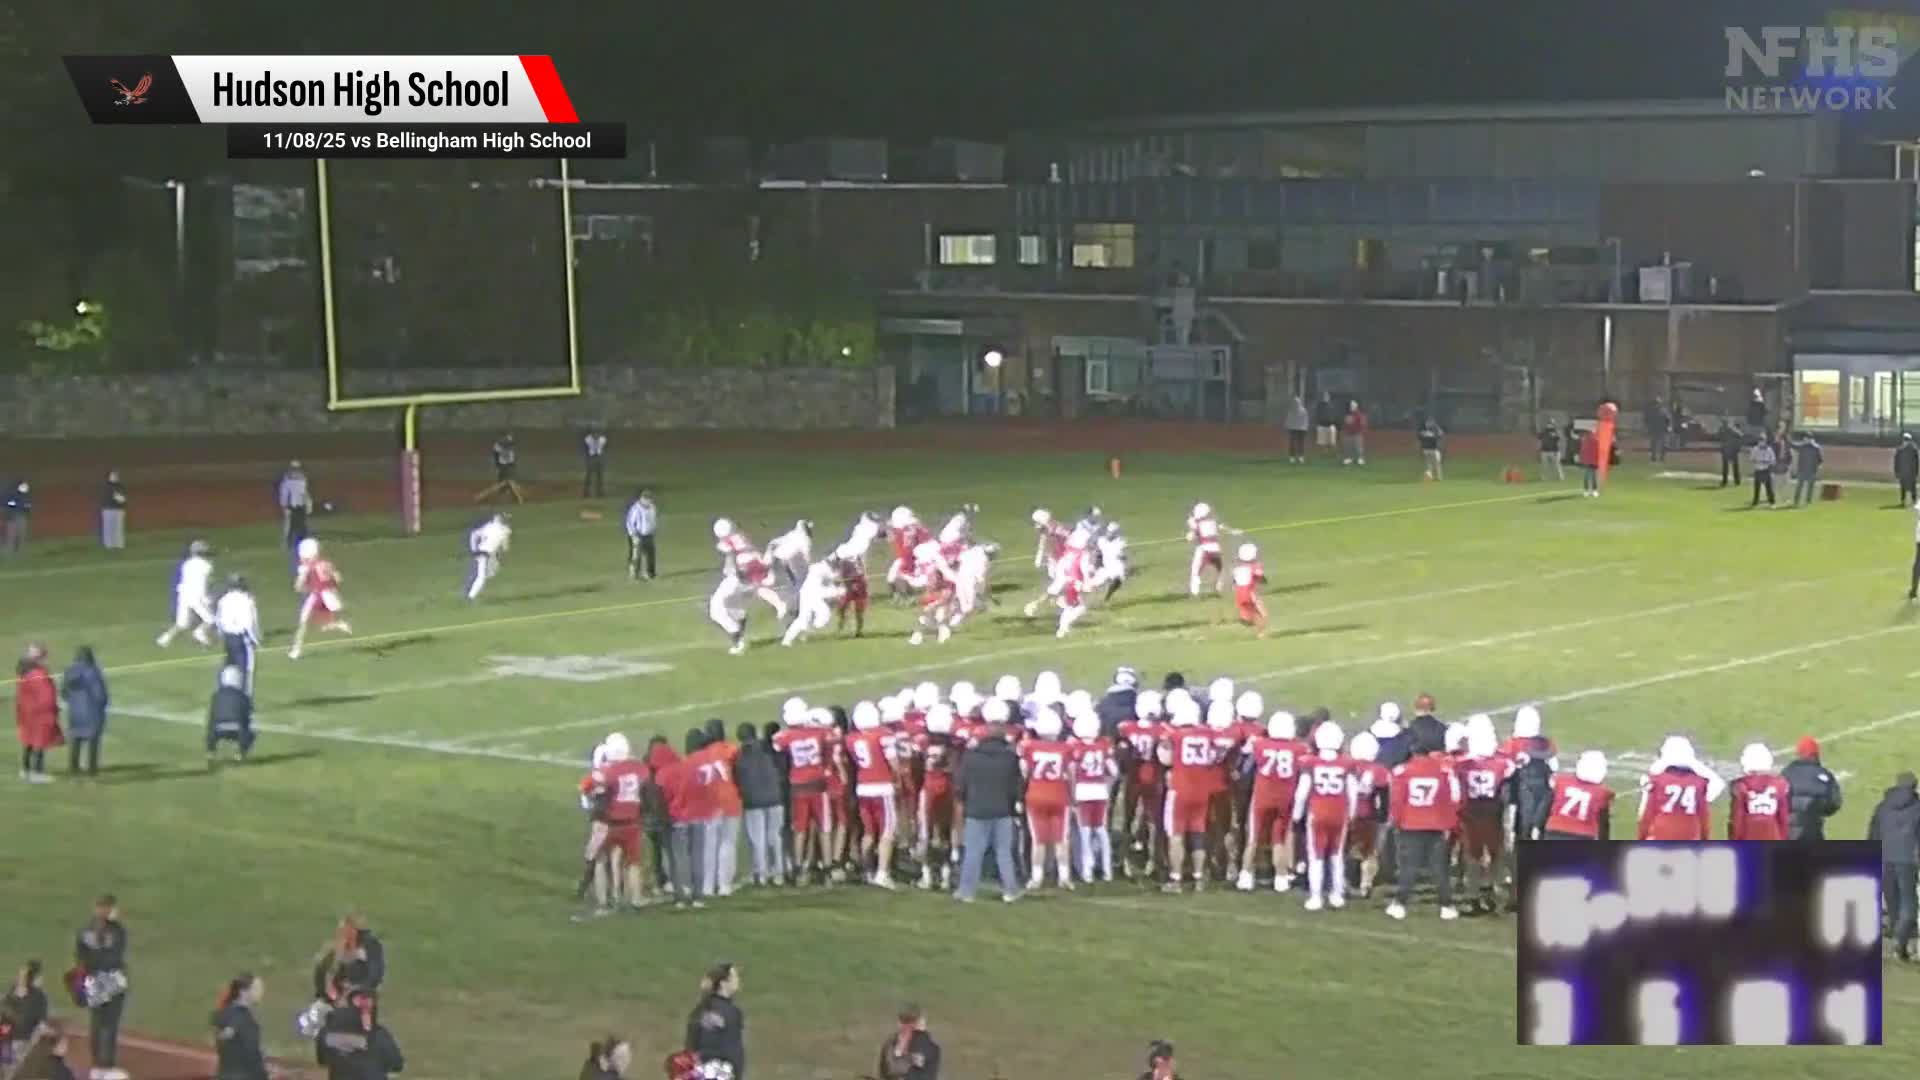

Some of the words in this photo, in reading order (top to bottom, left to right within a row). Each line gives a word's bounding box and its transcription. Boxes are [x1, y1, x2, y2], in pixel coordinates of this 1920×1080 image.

[1032, 751, 1063, 780] 73
[1181, 736, 1211, 766] 63
[1260, 748, 1294, 779] 78
[1313, 765, 1345, 796] 55
[1407, 777, 1439, 807] 57
[1559, 786, 1592, 821] 71
[1663, 784, 1697, 815] 74
